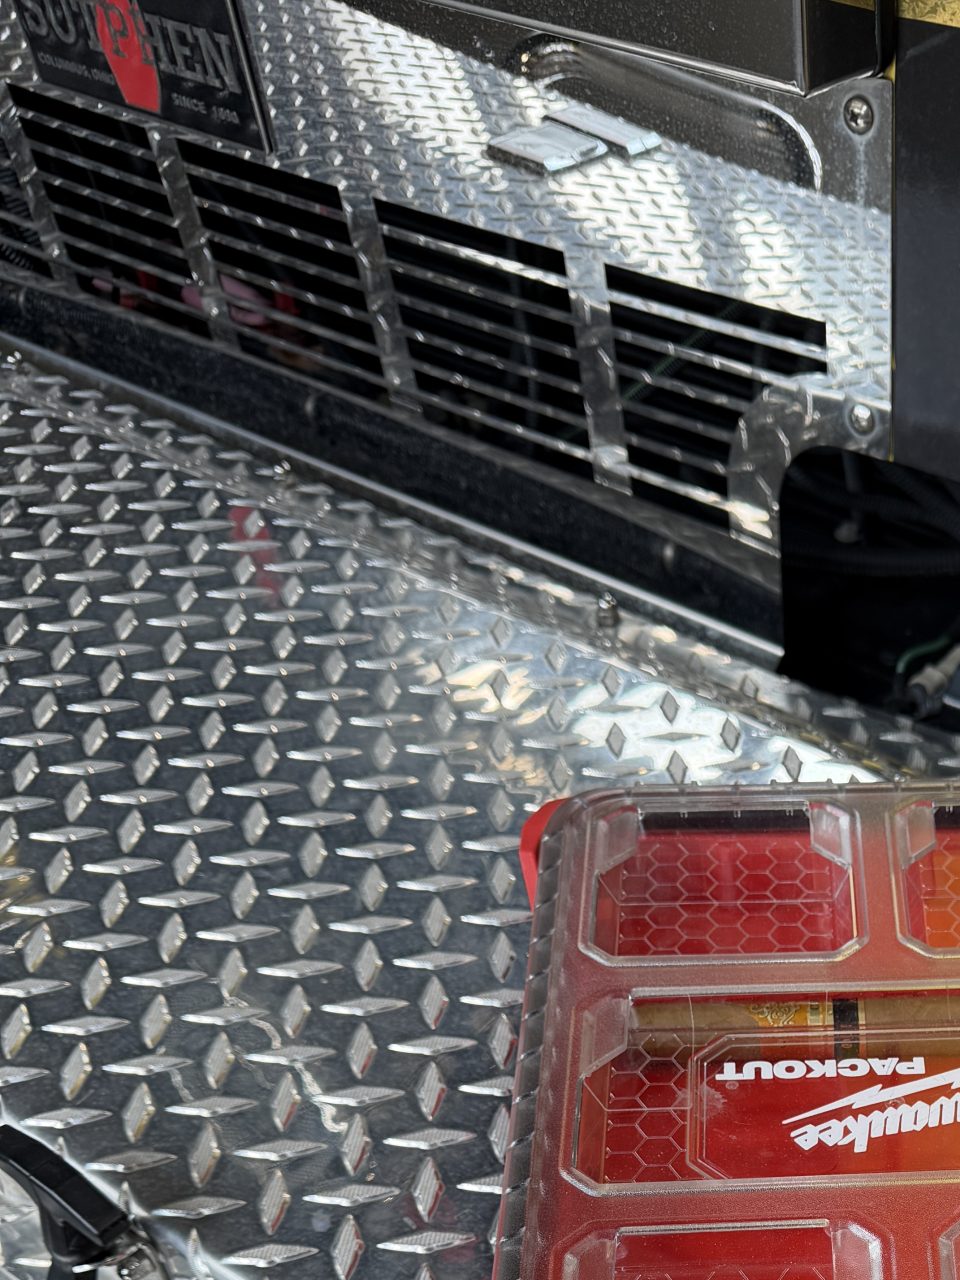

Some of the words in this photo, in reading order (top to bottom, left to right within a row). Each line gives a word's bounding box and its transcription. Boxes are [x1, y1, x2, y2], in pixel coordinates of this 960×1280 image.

[22, 0, 242, 95] SUTPHEN
[171, 92, 207, 114] SINCE
[715, 1056, 926, 1081] PACKOUT
